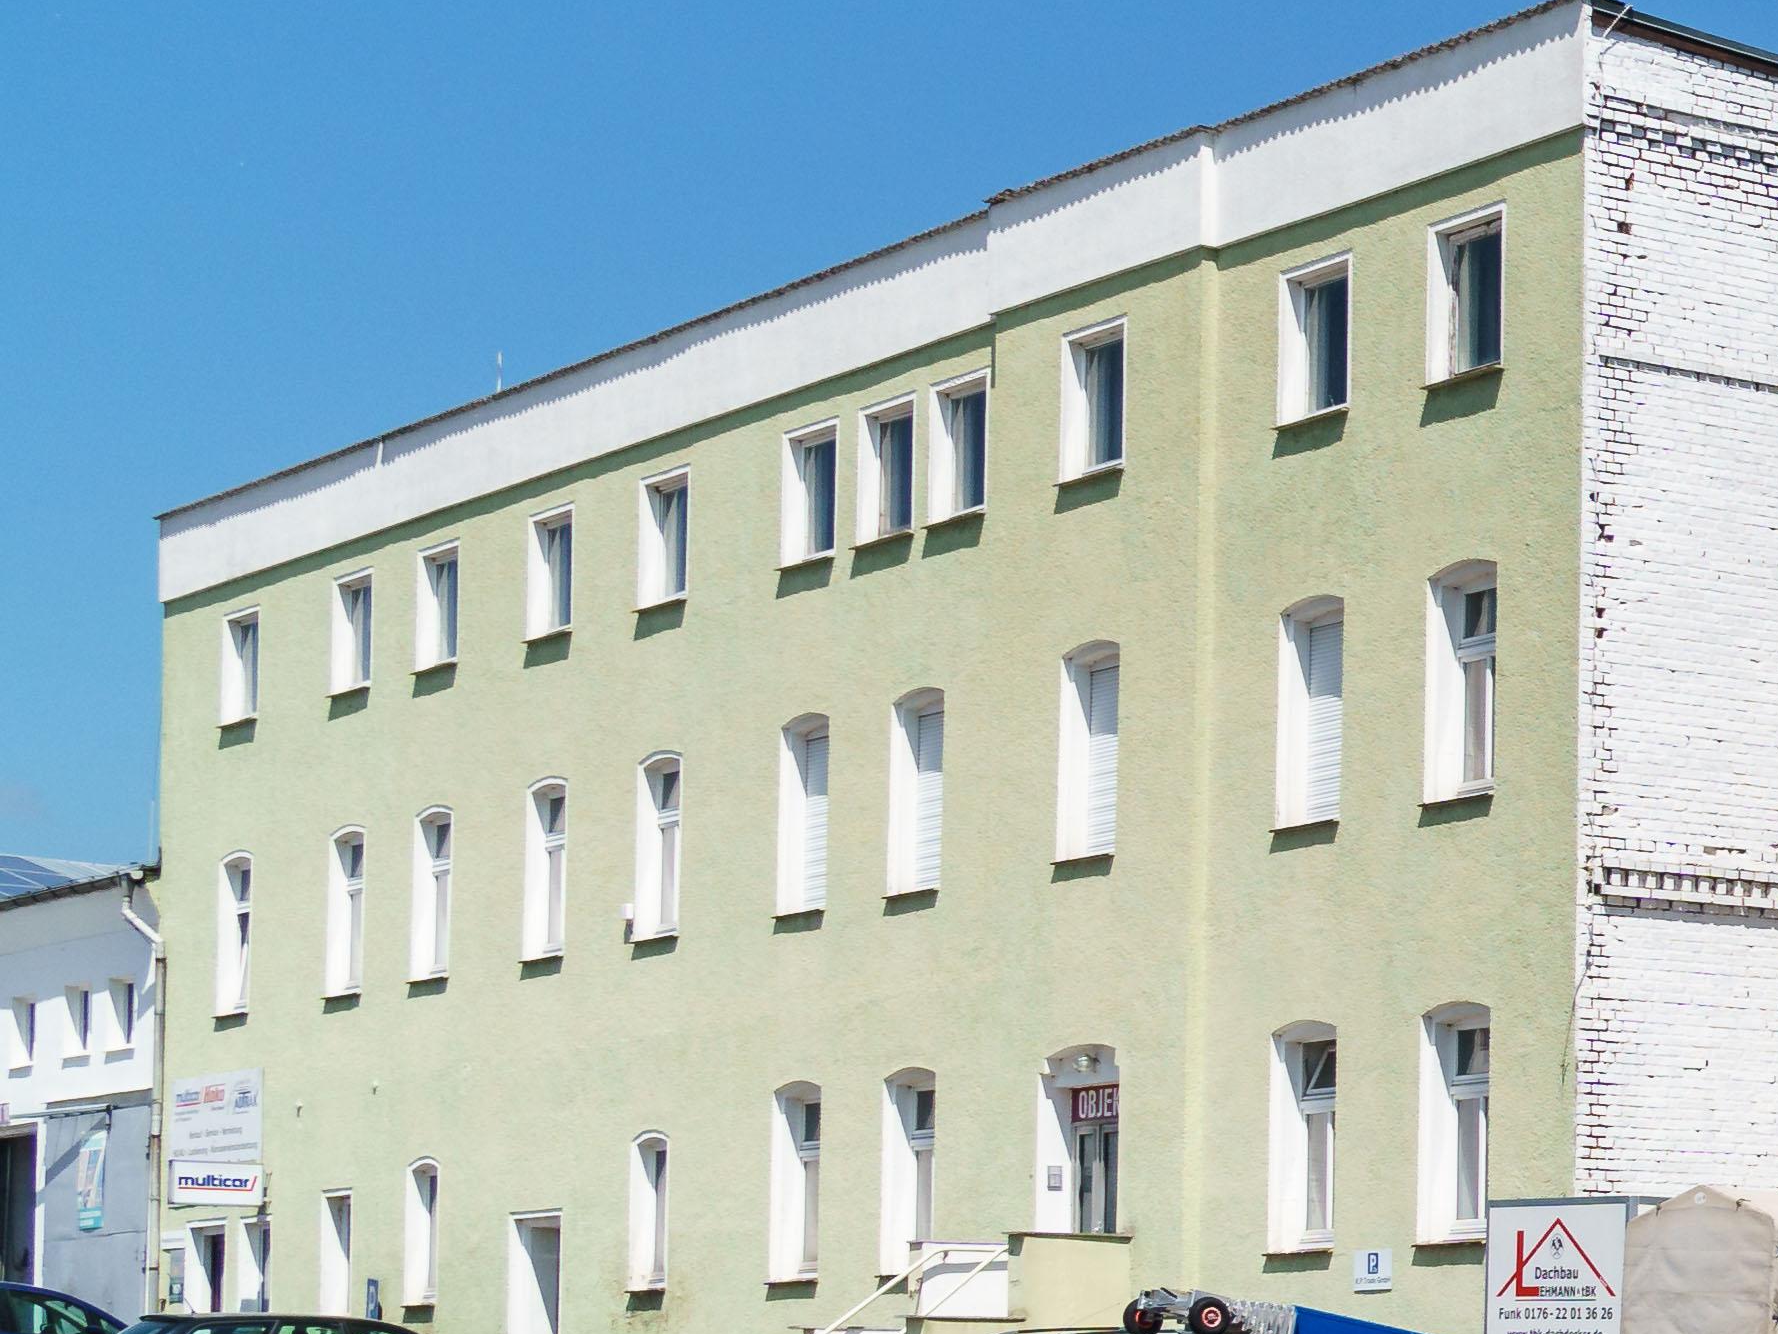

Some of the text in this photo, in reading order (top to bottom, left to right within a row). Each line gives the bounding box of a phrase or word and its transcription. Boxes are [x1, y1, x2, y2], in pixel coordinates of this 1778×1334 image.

[178, 1174, 250, 1188] multicar
[1534, 1266, 1579, 1280] Dachbau
[1499, 1307, 1522, 1320] Funk
[1570, 1307, 1582, 1320] 01
[1585, 1307, 1598, 1320] 36
[1601, 1307, 1613, 1320] 26
